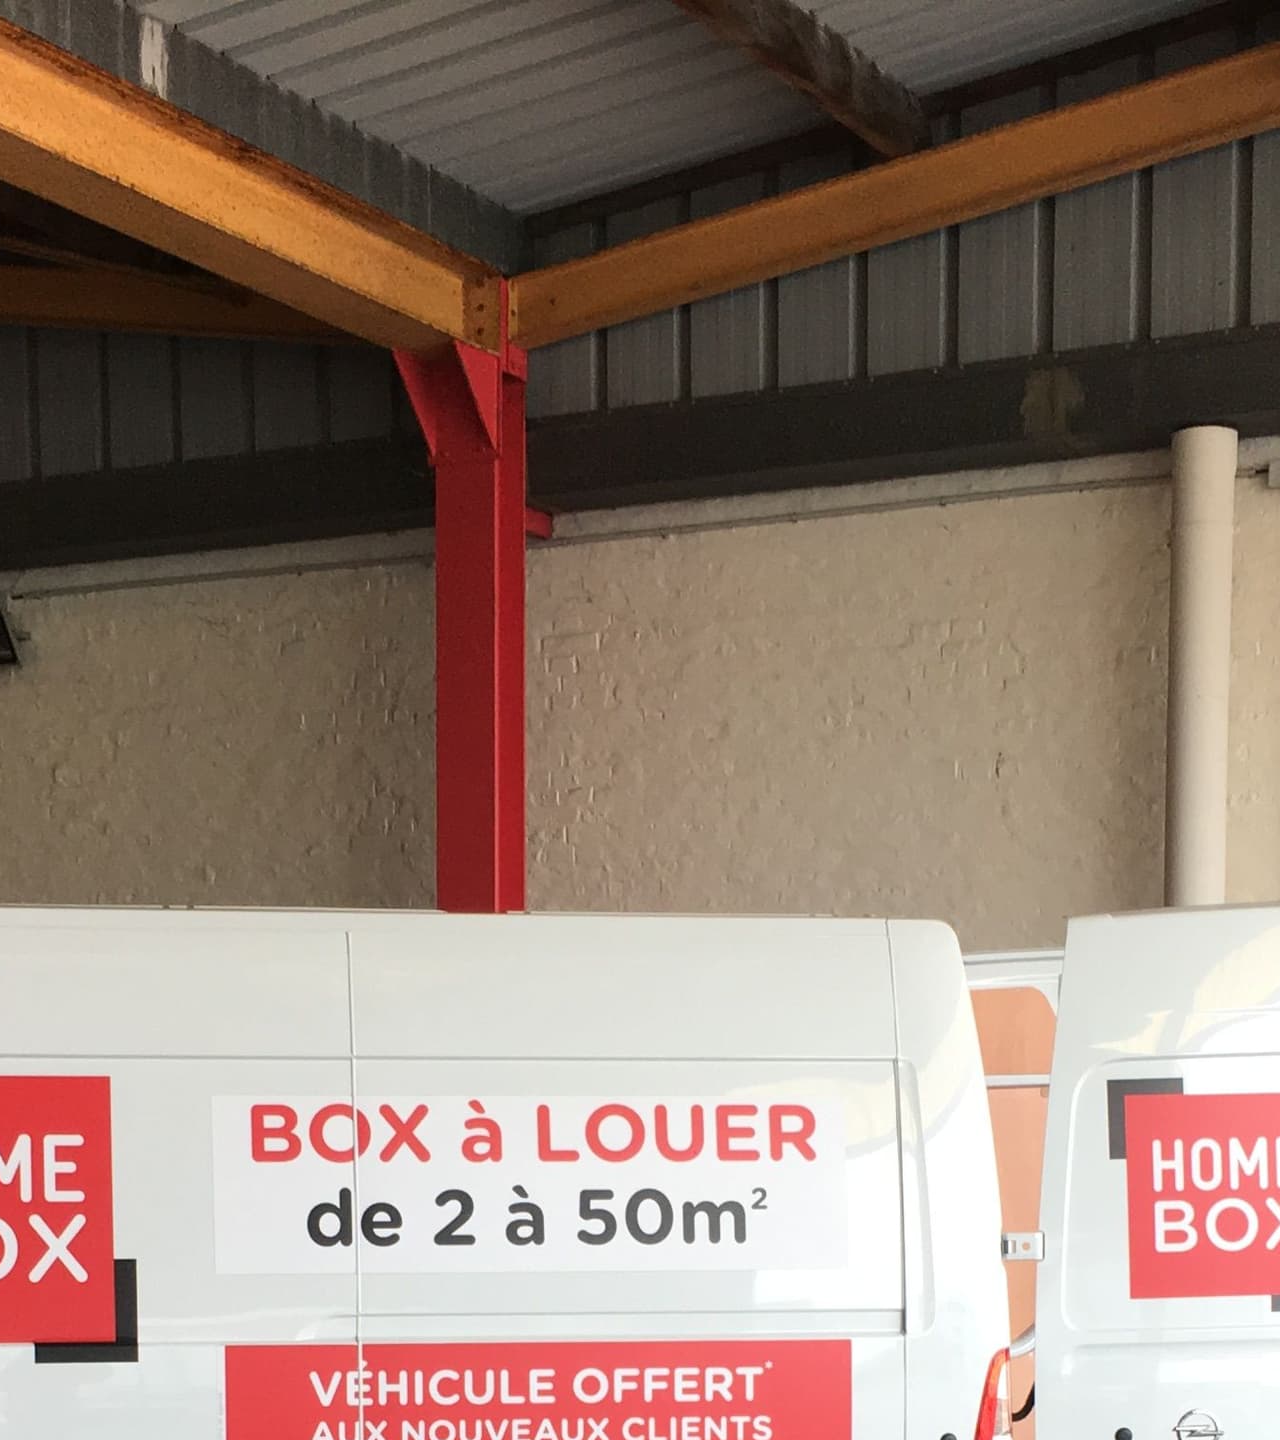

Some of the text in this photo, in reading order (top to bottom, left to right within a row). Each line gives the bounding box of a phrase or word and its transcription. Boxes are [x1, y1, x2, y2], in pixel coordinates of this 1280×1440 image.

[250, 1099, 817, 1163] BOX à LOUER
[307, 1187, 403, 1247] de
[433, 1188, 477, 1246] 2
[505, 1184, 546, 1246] à
[310, 1360, 556, 1407] VÉHICULE
